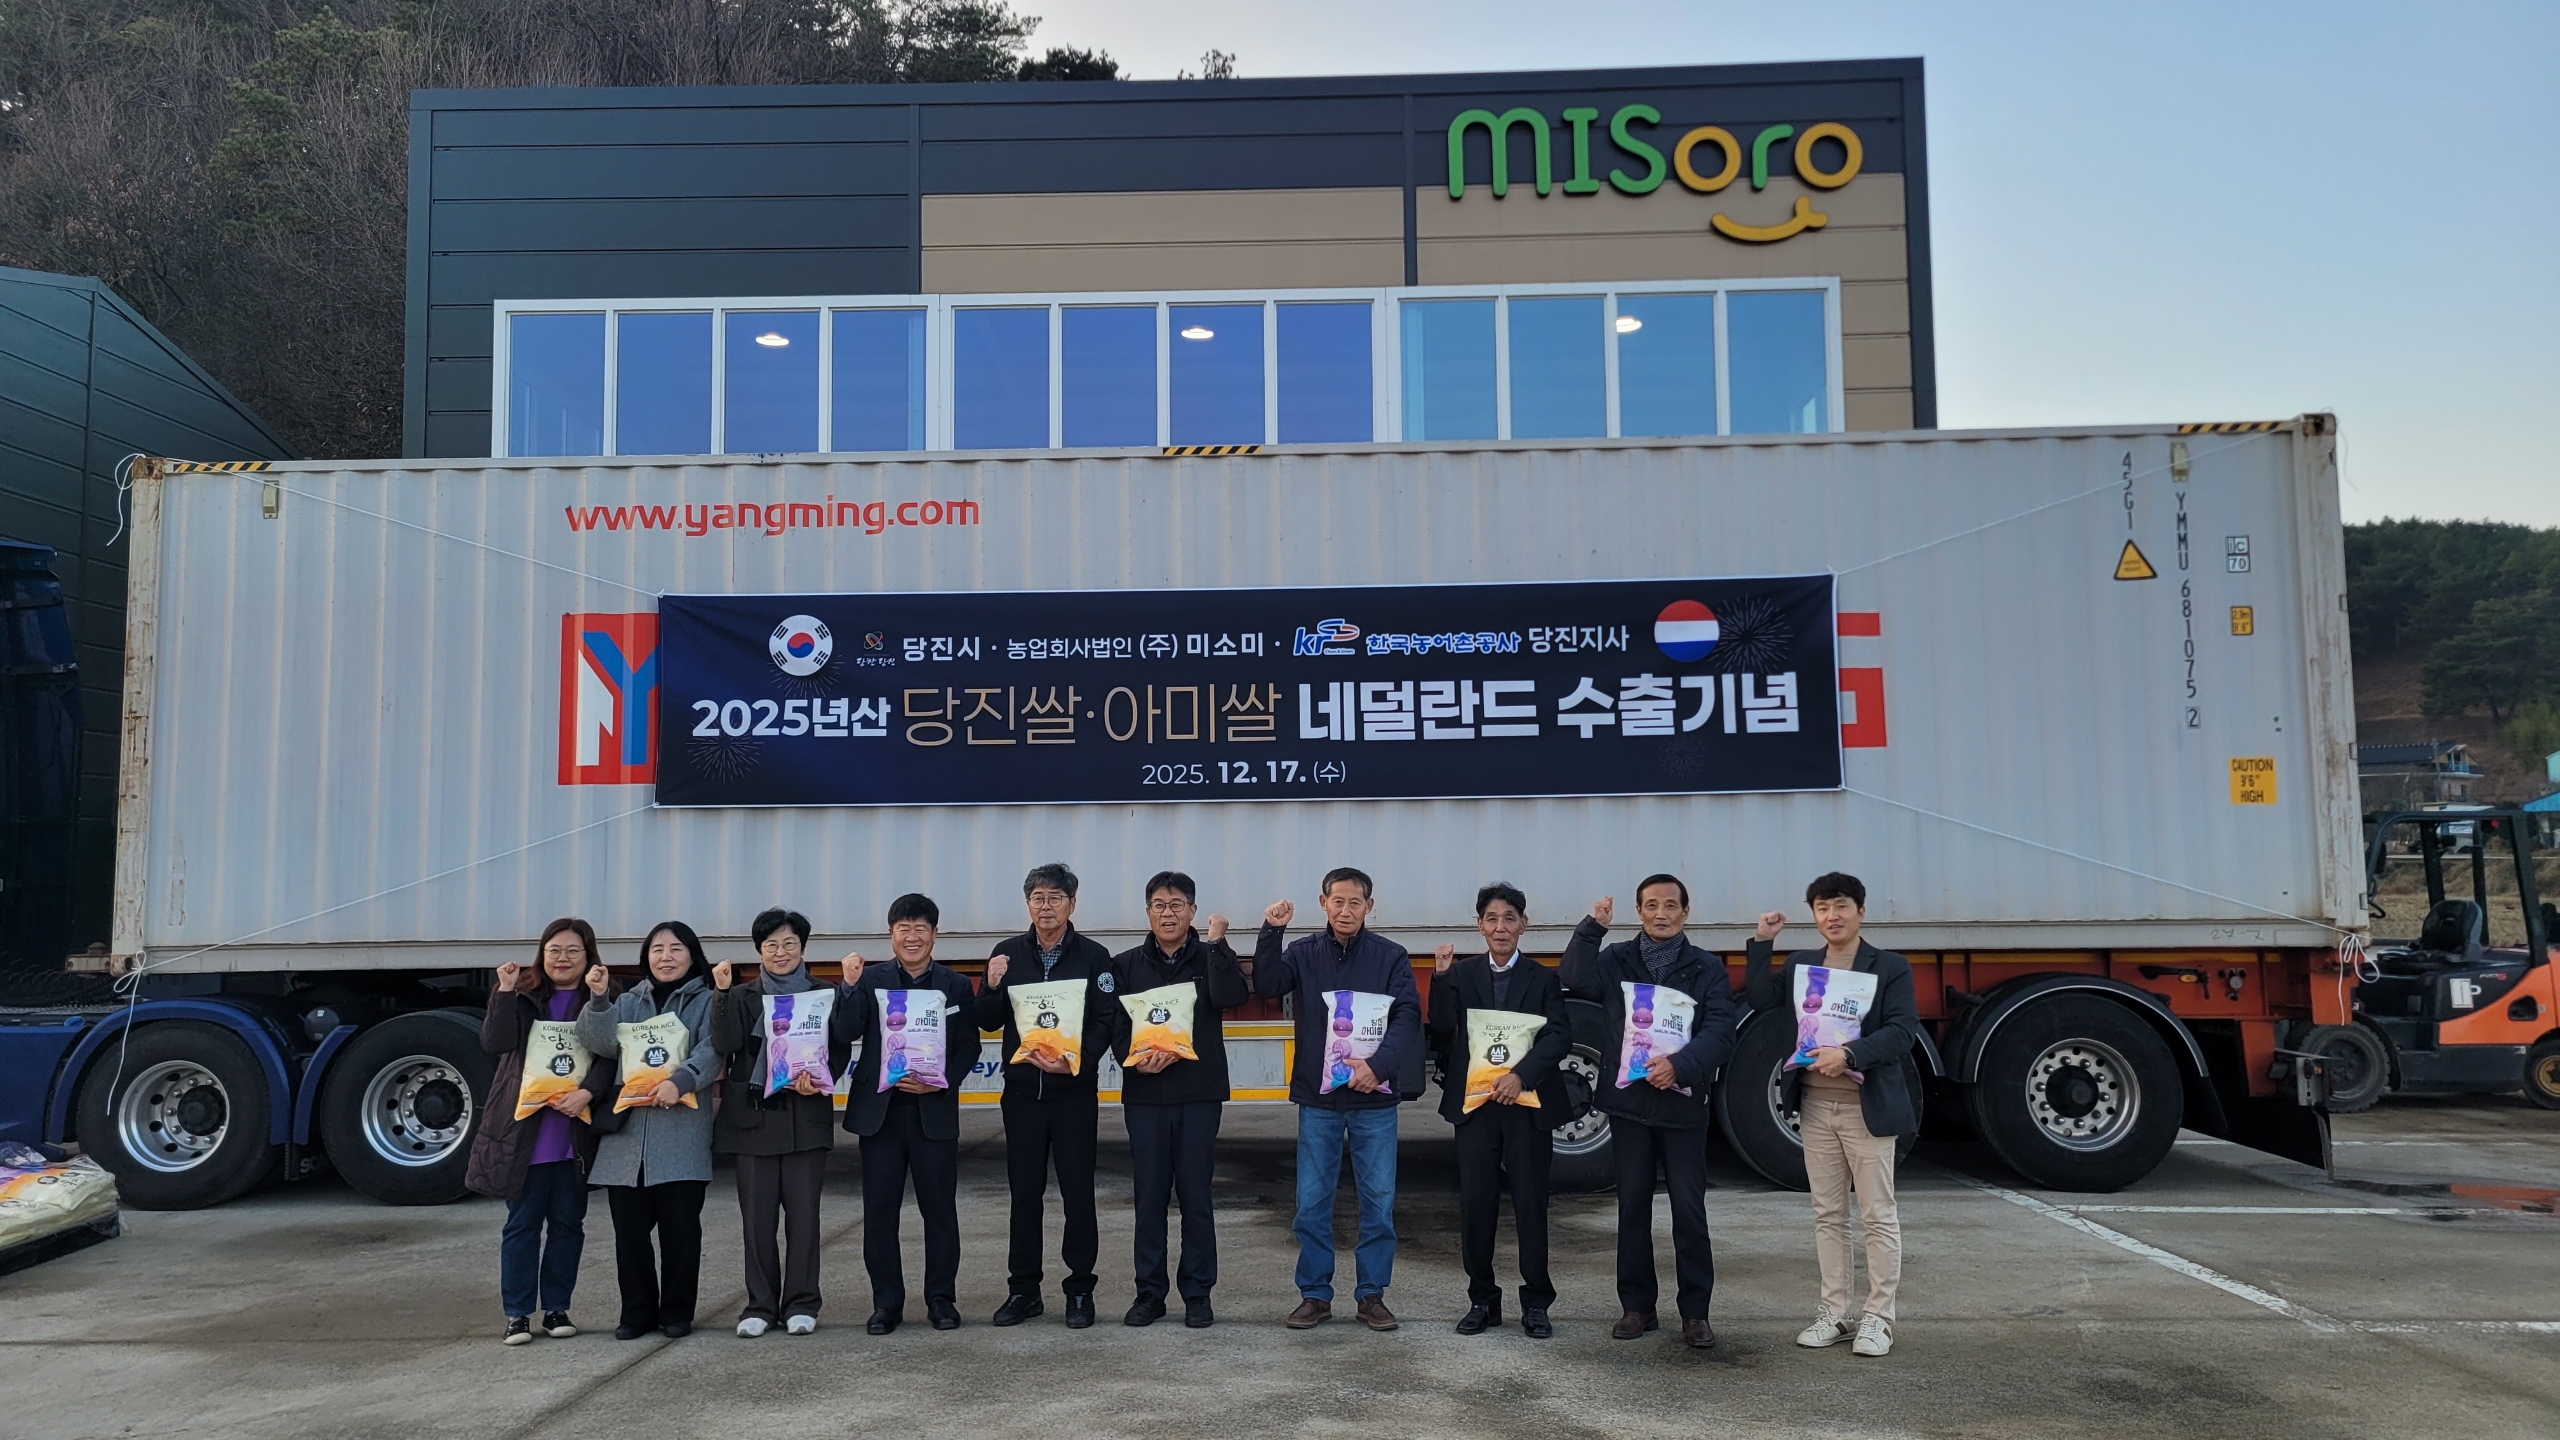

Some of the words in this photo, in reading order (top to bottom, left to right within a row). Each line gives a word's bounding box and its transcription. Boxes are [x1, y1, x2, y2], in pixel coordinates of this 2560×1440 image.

[565, 495, 979, 536] www.yangming.com
[2175, 491, 2189, 570] YMMU
[2230, 557, 2247, 570] 70
[903, 637, 980, 662] 당진시
[1006, 636, 1132, 660] 농업회사법인
[1139, 633, 1179, 659] (주)
[1186, 632, 1264, 658] 미소미
[1366, 631, 1522, 656] 한국농어촌공사
[1529, 625, 1630, 654] 당진지사
[2181, 579, 2198, 698] 681075
[692, 696, 891, 737] 2025년산
[1299, 680, 1540, 742] 네덜란드
[1557, 671, 1800, 739] 수출기념
[2188, 708, 2199, 727] 2
[1141, 764, 1210, 785] 2025.
[1217, 761, 1258, 784] 12.
[1266, 760, 1307, 783] 17.
[1313, 761, 1346, 784] (수)
[2231, 758, 2274, 772] CAUTION
[2240, 789, 2264, 803] HIGH
[1151, 1009, 1168, 1023] 쌀
[543, 1025, 568, 1034] KOREAN
[632, 1024, 659, 1032] KOREAN
[648, 1049, 666, 1065] 쌀
[1490, 1046, 1507, 1063] 쌀
[555, 1056, 572, 1074] 쌀
